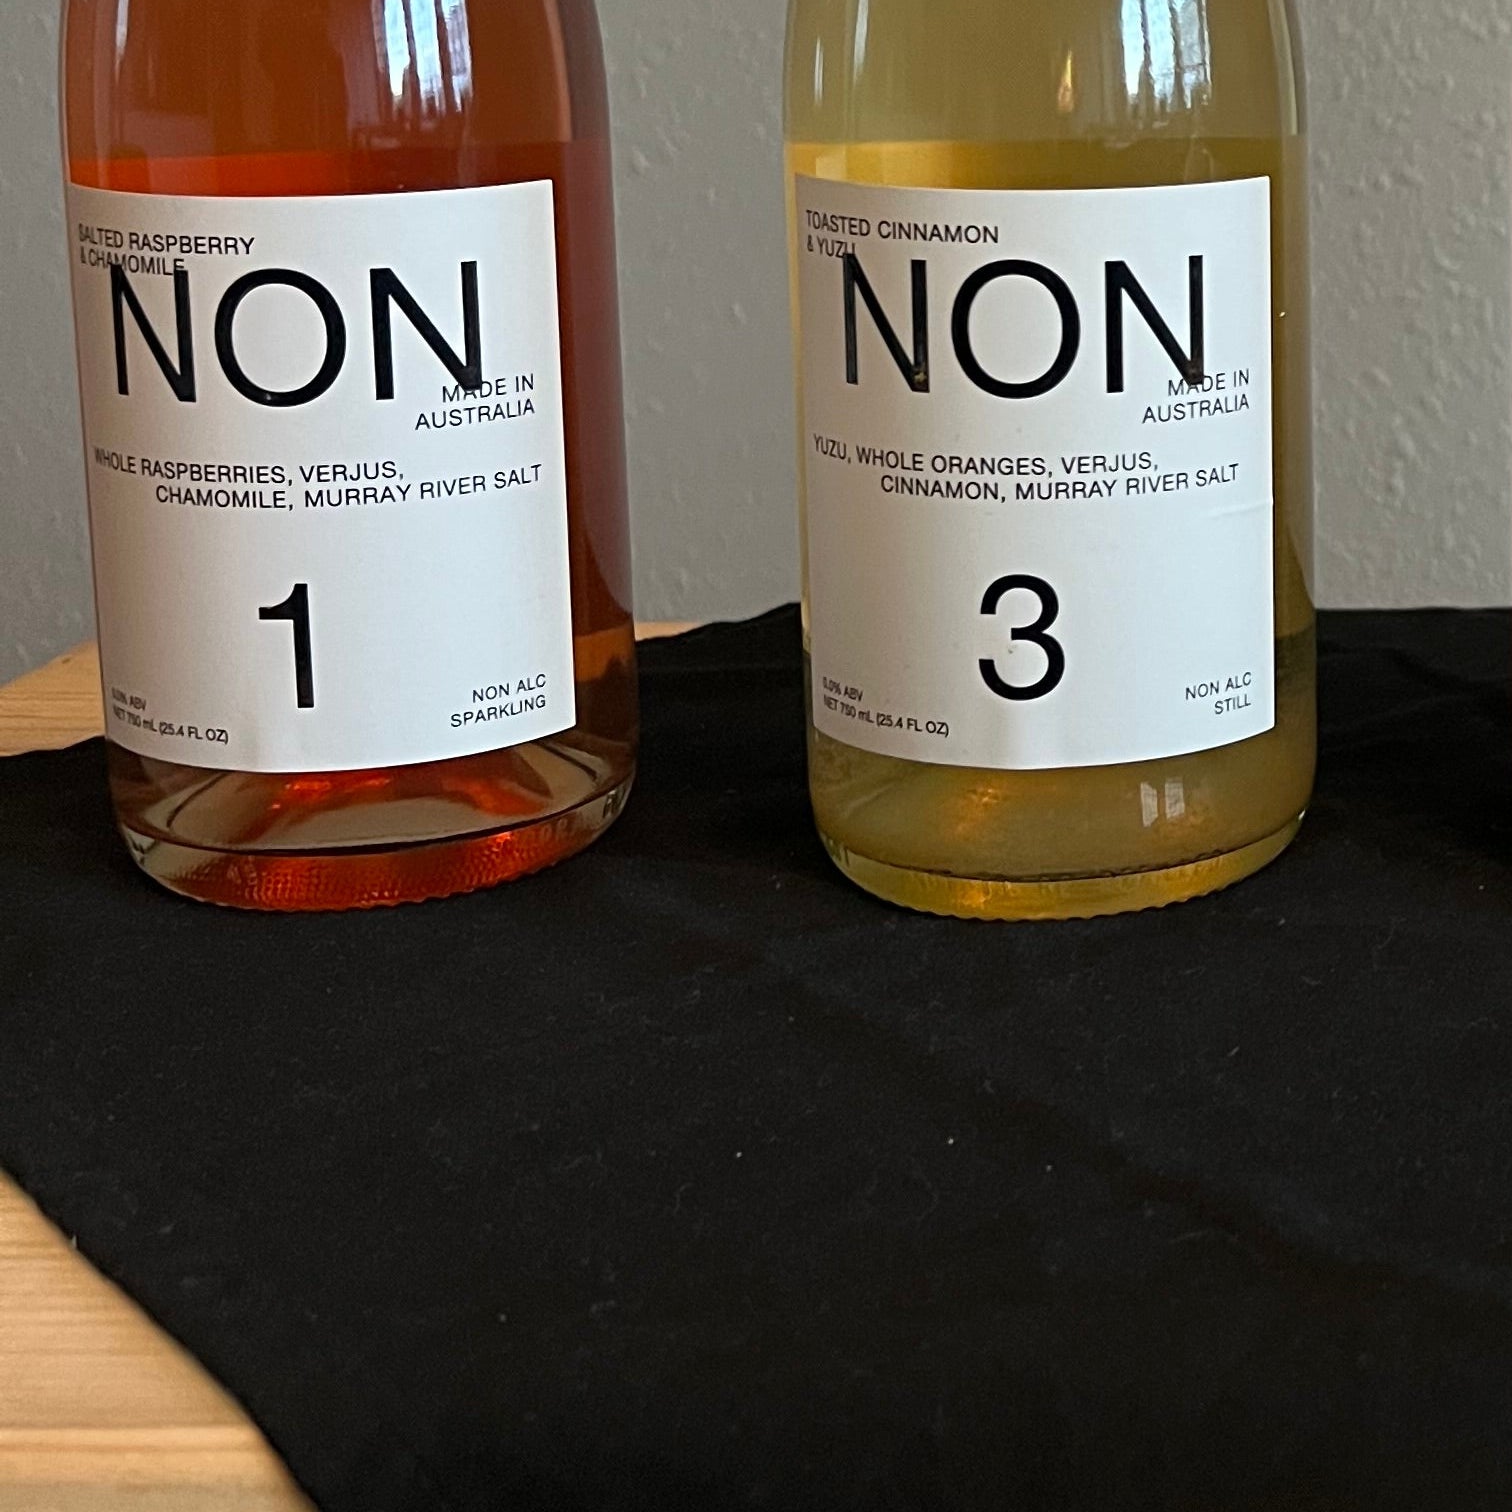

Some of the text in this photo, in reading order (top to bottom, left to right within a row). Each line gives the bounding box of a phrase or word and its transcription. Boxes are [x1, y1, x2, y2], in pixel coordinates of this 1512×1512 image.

[806, 209, 999, 244] TOASTED CINNAMON
[129, 232, 255, 255] RASPBERRY
[111, 261, 482, 407] NON
[843, 254, 1204, 399] NON
[515, 373, 534, 393] IN
[1233, 368, 1249, 387] IN
[414, 398, 535, 430] AUSTRALIA
[1142, 393, 1250, 424] AUSTRALIA
[813, 433, 1158, 478] YUZU, WHOLE ORANGES, VERJUS,
[141, 458, 293, 486] RASPBERRIES,
[299, 460, 404, 482] VERJUS,
[156, 464, 542, 511] CHAMOMILE, MURRAY RIVER SALT
[880, 463, 1240, 503] CINNAMON, MURRAY RIVER SALT
[258, 583, 315, 708] 1
[978, 573, 1066, 701] 3
[472, 673, 546, 703] NON ALC
[1186, 672, 1251, 700] NON ALC
[450, 694, 546, 728] SPARKLING
[1214, 694, 1251, 715] STILL
[205, 728, 229, 745] OZ)
[907, 718, 922, 732] FL
[925, 721, 949, 738] OZ)
